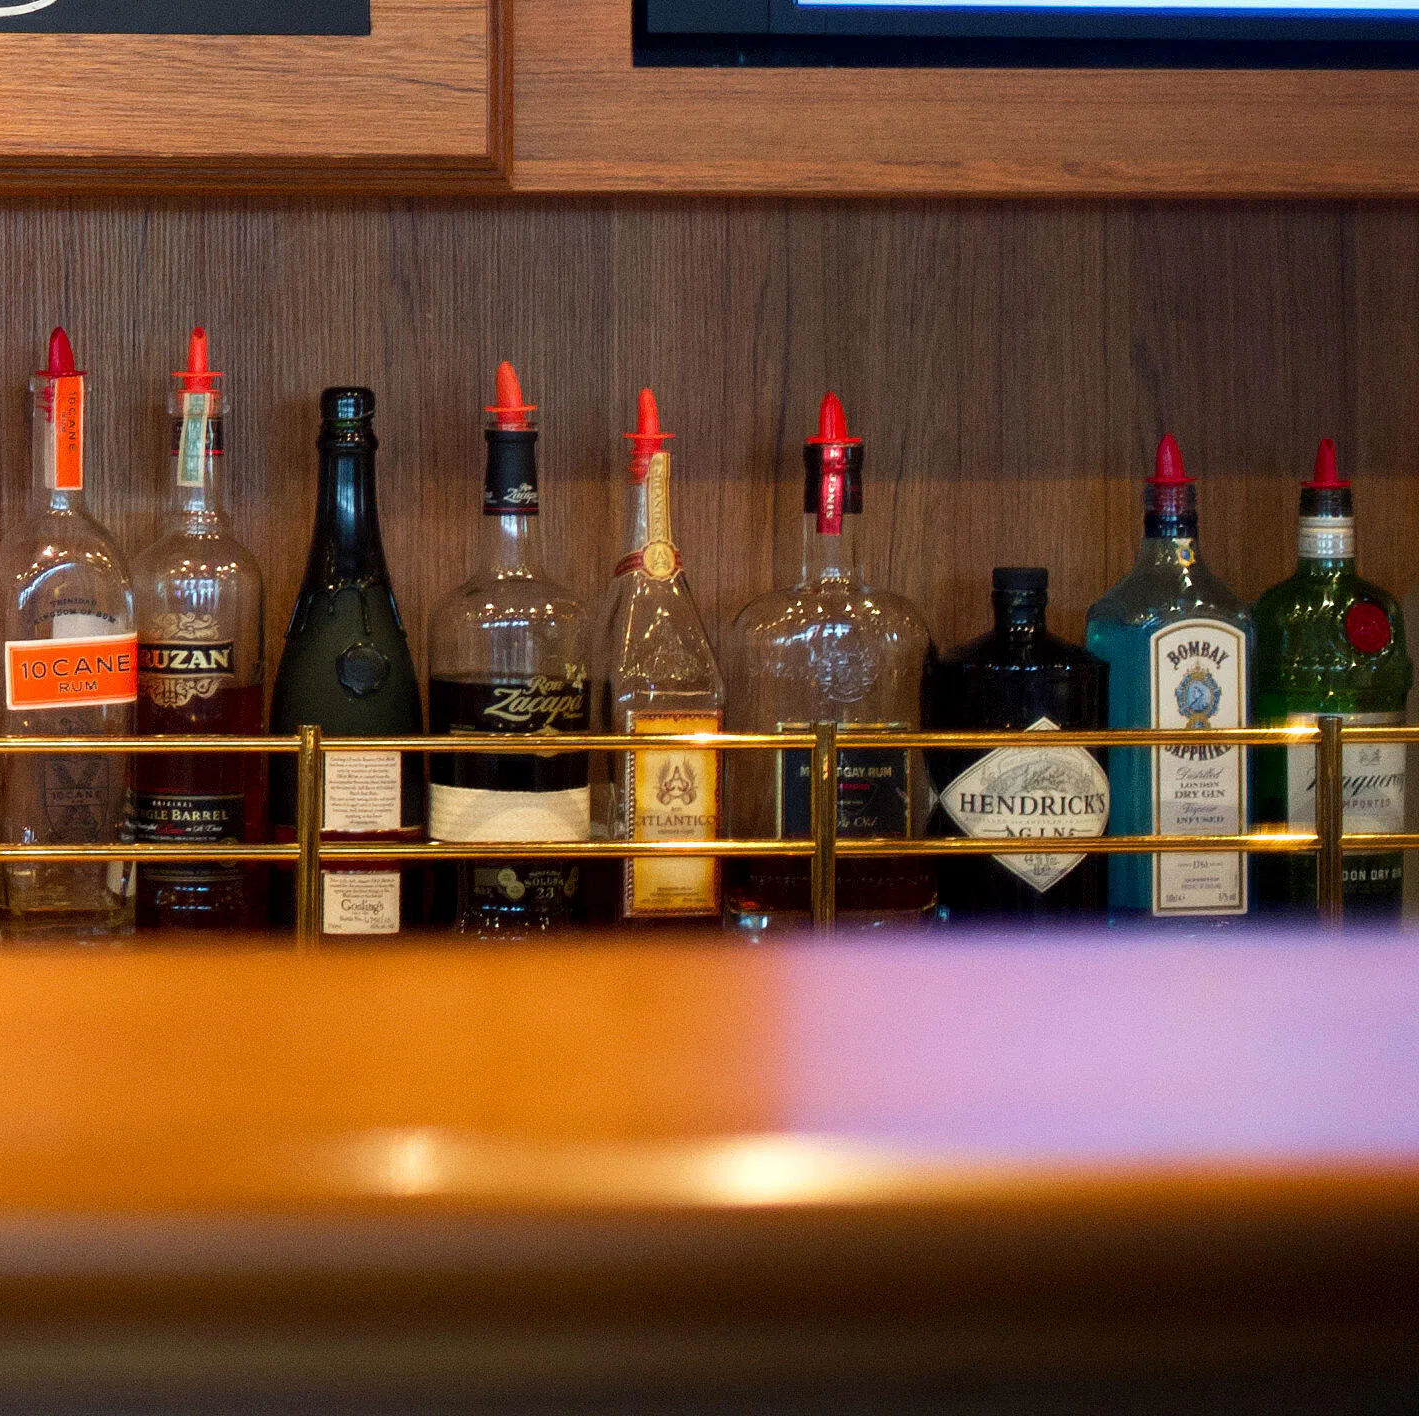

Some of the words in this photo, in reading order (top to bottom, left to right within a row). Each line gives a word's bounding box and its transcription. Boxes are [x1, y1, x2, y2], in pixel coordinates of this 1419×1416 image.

[1166, 640, 1230, 671] BOMBAY
[59, 680, 97, 692] RUM
[483, 688, 584, 725] Zacapa
[843, 766, 865, 778] GAY
[868, 765, 892, 778] RUM
[1174, 790, 1199, 799] DRY
[1201, 789, 1225, 799] GIN
[959, 792, 1106, 816] HENDRICK'S
[171, 809, 229, 822] BARREL
